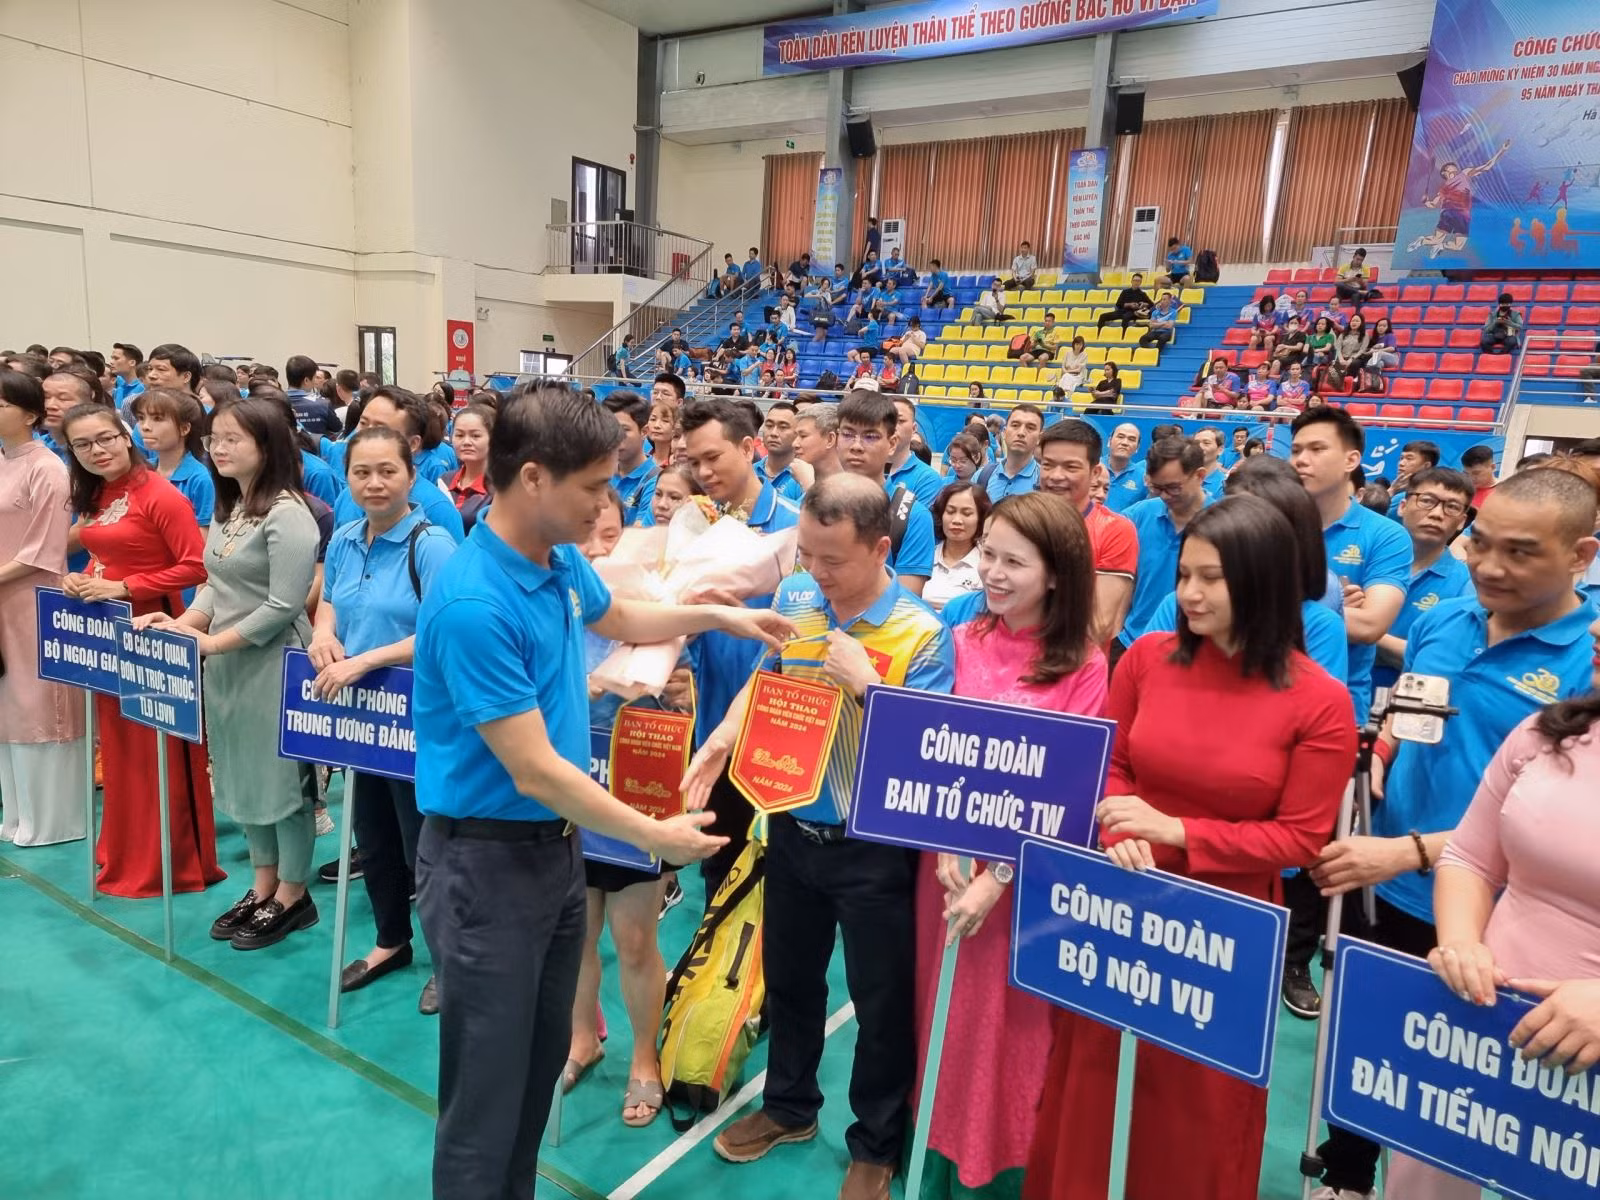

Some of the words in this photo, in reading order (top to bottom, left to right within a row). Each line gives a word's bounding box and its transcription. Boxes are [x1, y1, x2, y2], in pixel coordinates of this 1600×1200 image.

[779, 33, 810, 64] TOÀN
[811, 32, 837, 60] DÂN
[841, 27, 866, 56] RÈN
[868, 20, 909, 55] LUYỆN
[912, 15, 947, 45] THÂN
[951, 4, 978, 40] THỂ
[980, 10, 1016, 36] THEO
[1019, 0, 1072, 31] GƯƠNG
[1513, 36, 1558, 58] CÔNG
[1546, 64, 1559, 78] 30
[1520, 87, 1533, 101] 95
[52, 608, 84, 634] CÔNG
[44, 638, 61, 664] BỘ
[63, 643, 98, 672] NGOẠI
[134, 631, 150, 657] CÁC
[152, 638, 163, 661] CƠ
[164, 642, 191, 671] QUAN,
[136, 664, 145, 691] VỊ
[145, 667, 166, 695] TRỰC
[166, 674, 195, 704] THUỘC
[357, 686, 407, 717] PHÒNG
[763, 685, 784, 696] BAN
[769, 697, 788, 709] HỘI
[789, 702, 818, 715] THAO
[286, 709, 333, 738] TRUNG
[335, 716, 375, 745] ƯƠNG
[648, 732, 674, 742] THAO
[920, 723, 981, 768] CÔNG
[983, 735, 1047, 779] ĐOÀN
[773, 781, 794, 793] 2024
[884, 777, 931, 816] BAN
[935, 776, 966, 821] TỔ
[965, 789, 1025, 832] CHỨC
[1030, 801, 1066, 838] TW
[1050, 882, 1133, 939] CÔNG
[1141, 910, 1236, 973] ĐOÀN
[1058, 938, 1098, 987] BỘ
[1106, 956, 1163, 1007] NỘI
[1170, 978, 1215, 1031] VỤ
[1403, 1010, 1502, 1079] CÔNG
[1351, 1056, 1409, 1112] ĐÀI
[1418, 1081, 1521, 1156] TIẾNG
